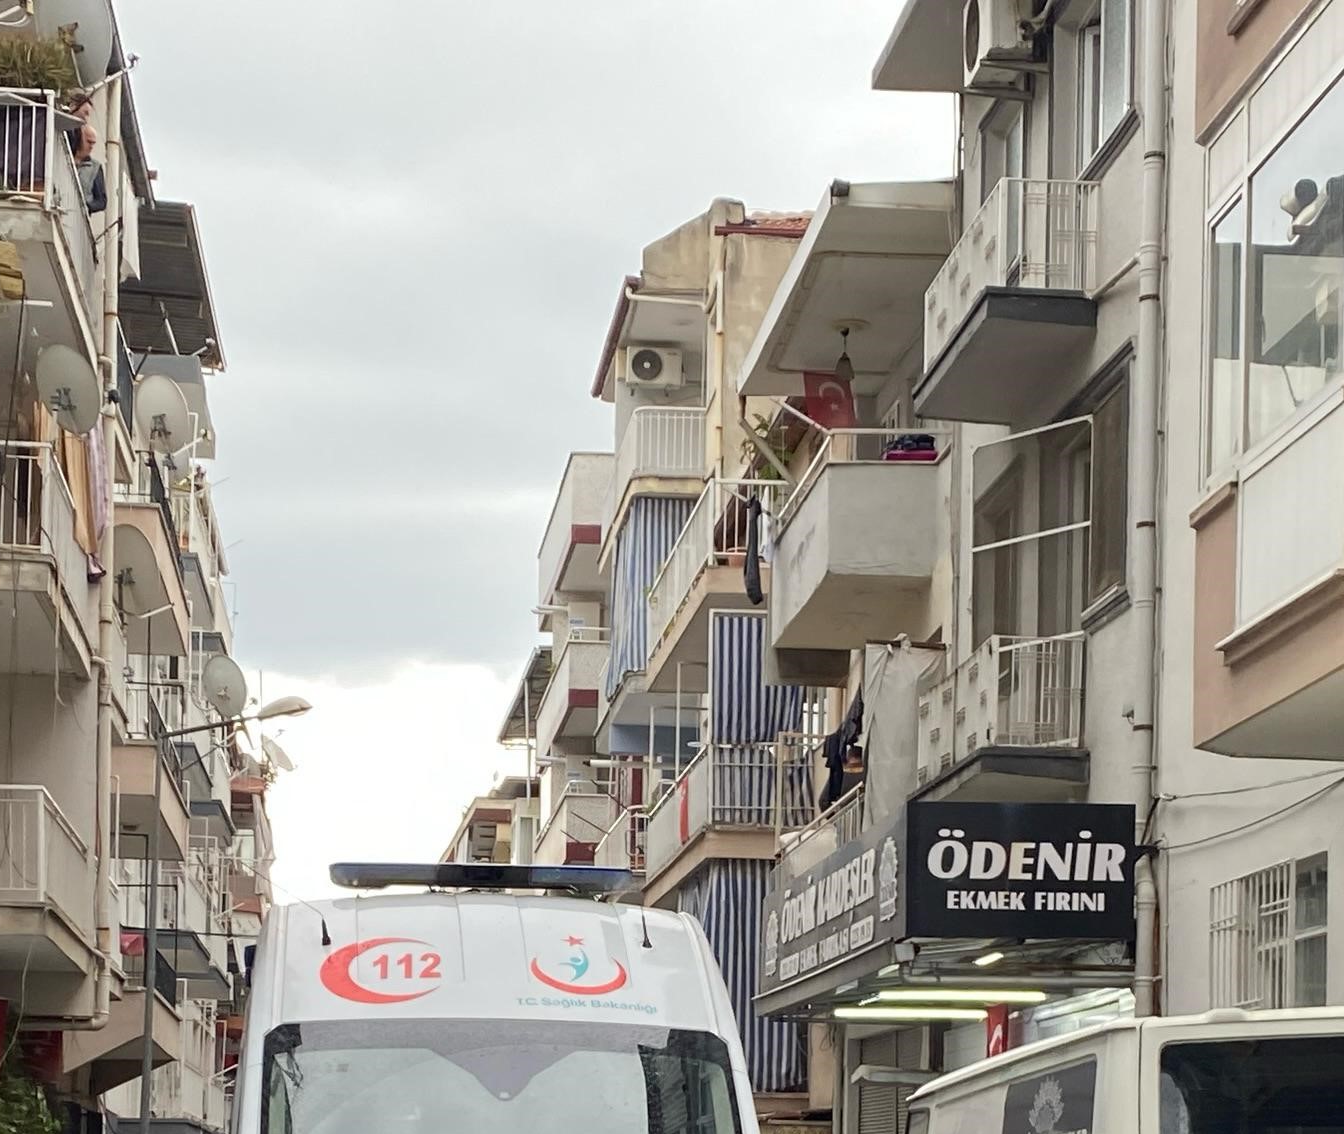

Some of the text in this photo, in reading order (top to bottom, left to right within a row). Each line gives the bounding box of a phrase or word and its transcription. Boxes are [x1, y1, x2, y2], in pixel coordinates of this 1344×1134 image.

[927, 828, 1126, 881] ÖDENİR
[946, 890, 1105, 911] EKMEK FIRINI
[372, 952, 442, 979] 112
[541, 998, 586, 1008] Sağlık
[590, 999, 657, 1014] Bakanlığı
